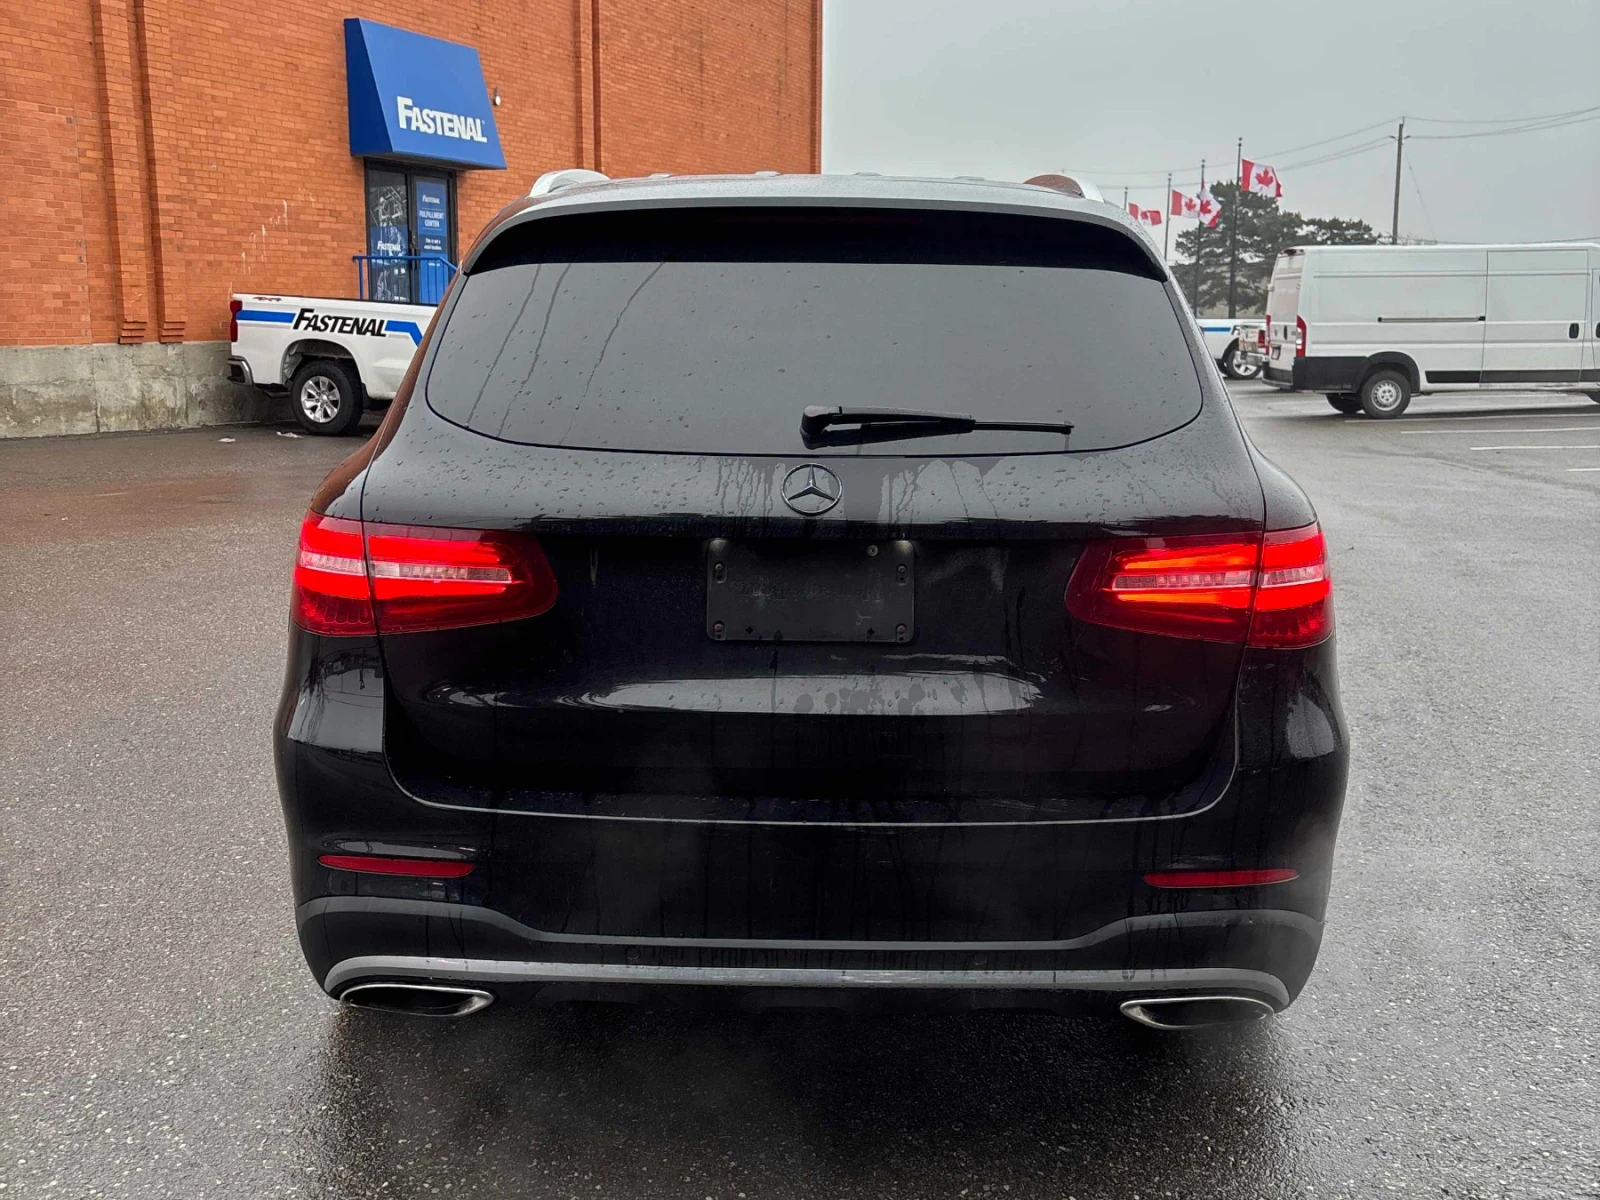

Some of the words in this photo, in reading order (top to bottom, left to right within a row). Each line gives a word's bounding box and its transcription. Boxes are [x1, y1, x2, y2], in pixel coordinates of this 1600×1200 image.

[397, 96, 487, 143] FASTENAL
[425, 219, 440, 227] CENTER
[293, 308, 386, 337] FASTENAL
